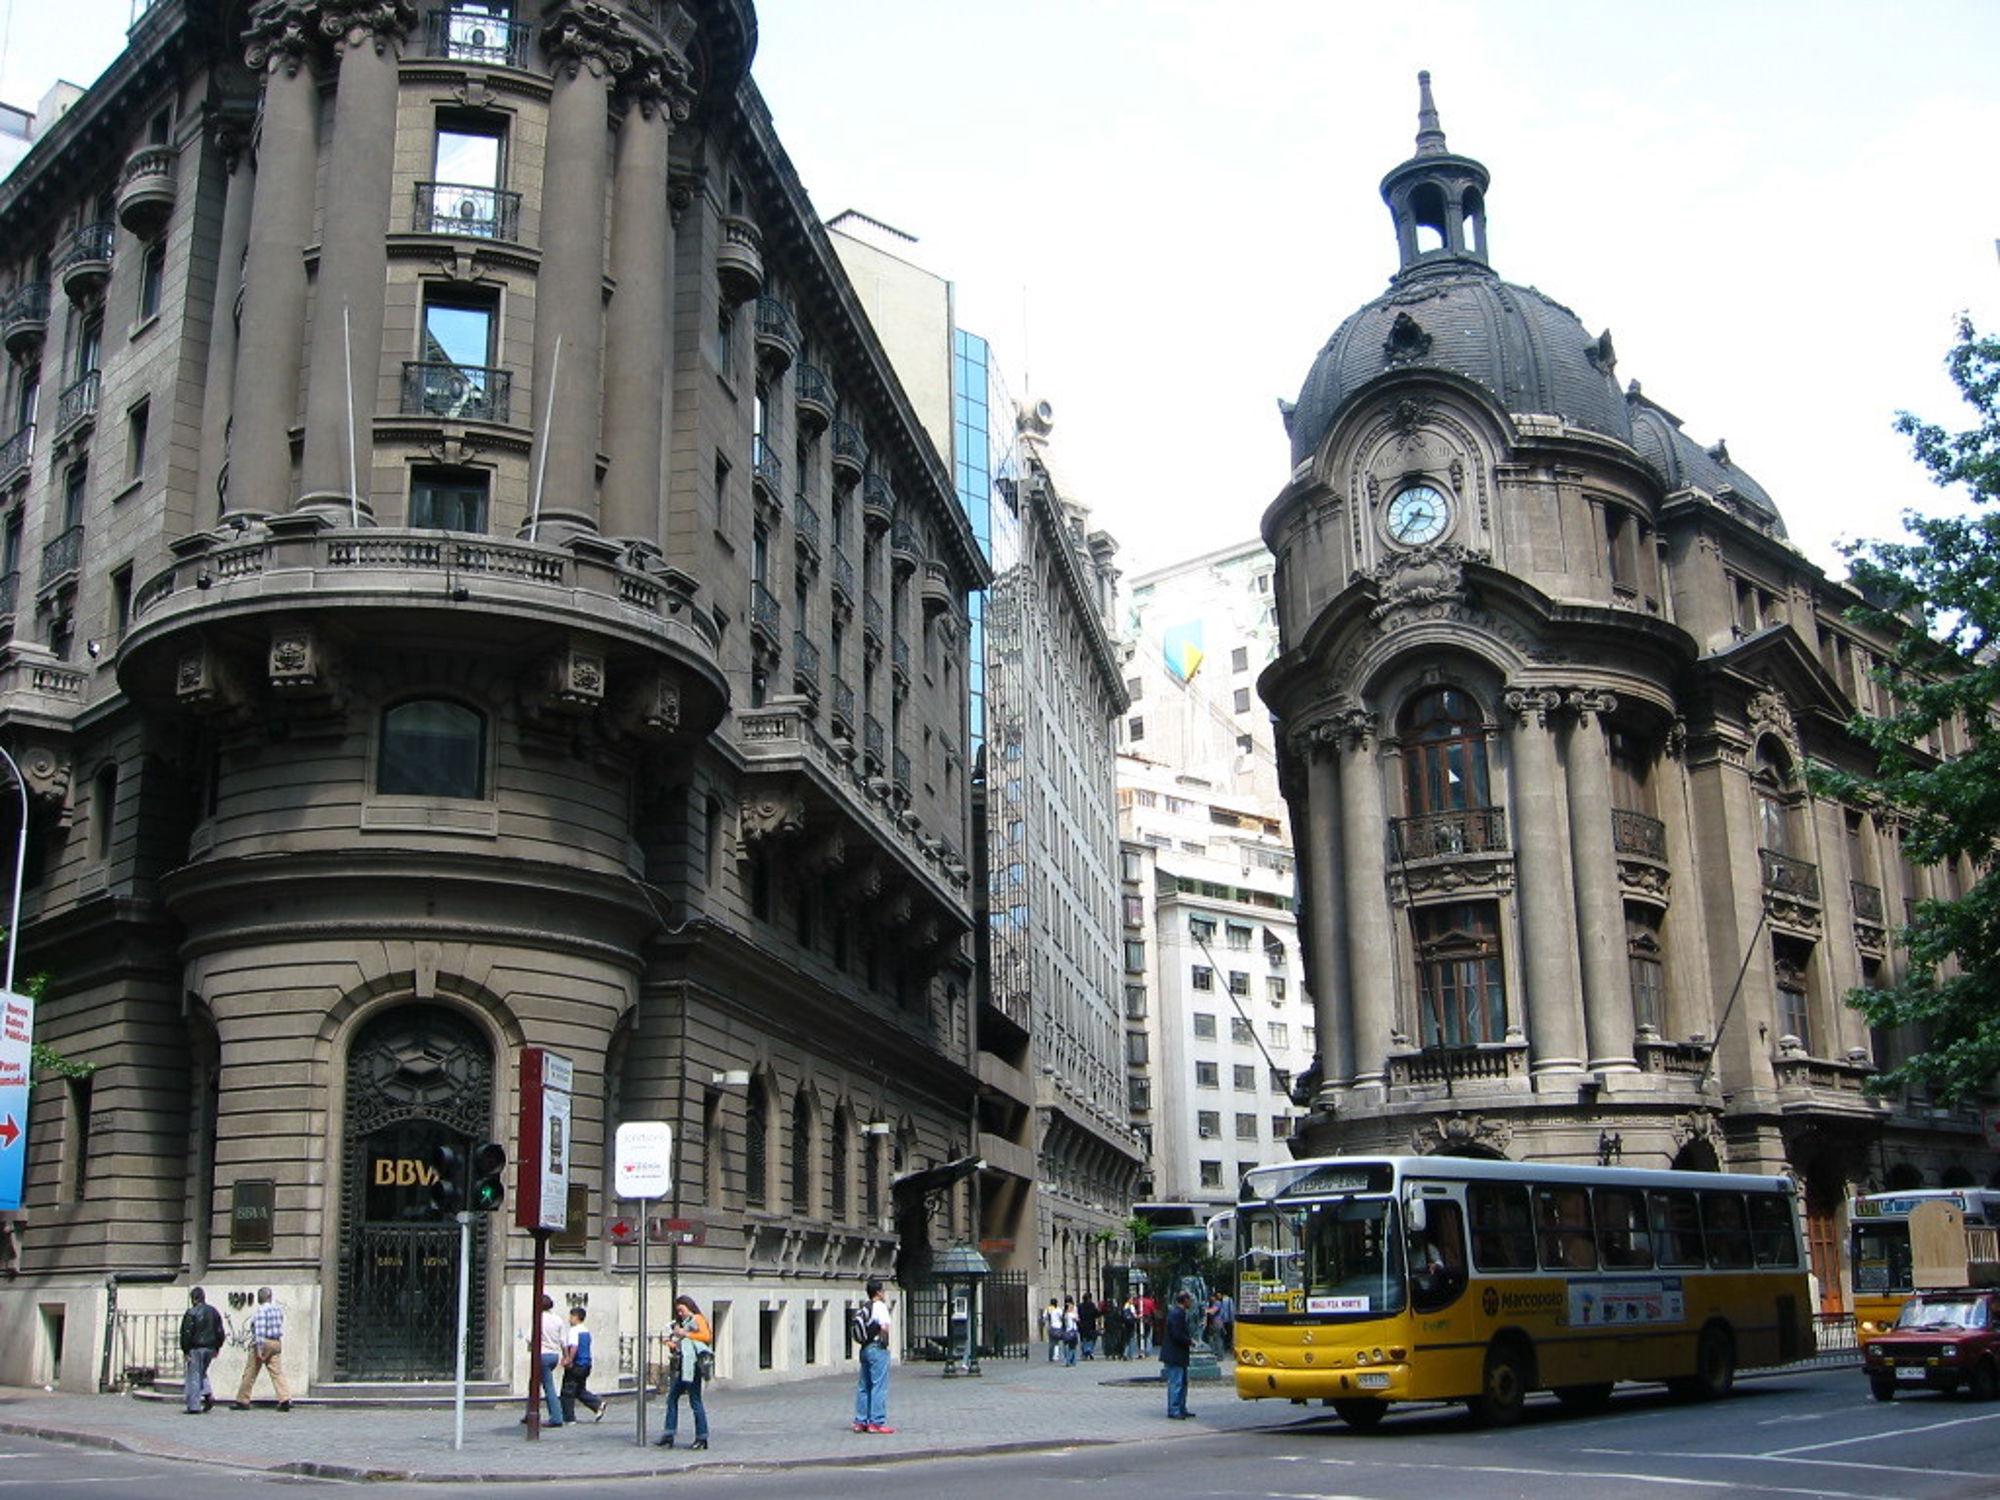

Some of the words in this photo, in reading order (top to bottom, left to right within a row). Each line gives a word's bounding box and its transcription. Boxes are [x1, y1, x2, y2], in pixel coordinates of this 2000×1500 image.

[1389, 614, 1410, 630] DE
[237, 1206, 268, 1219] BBVA
[1501, 1291, 1563, 1310] Marcopolo
